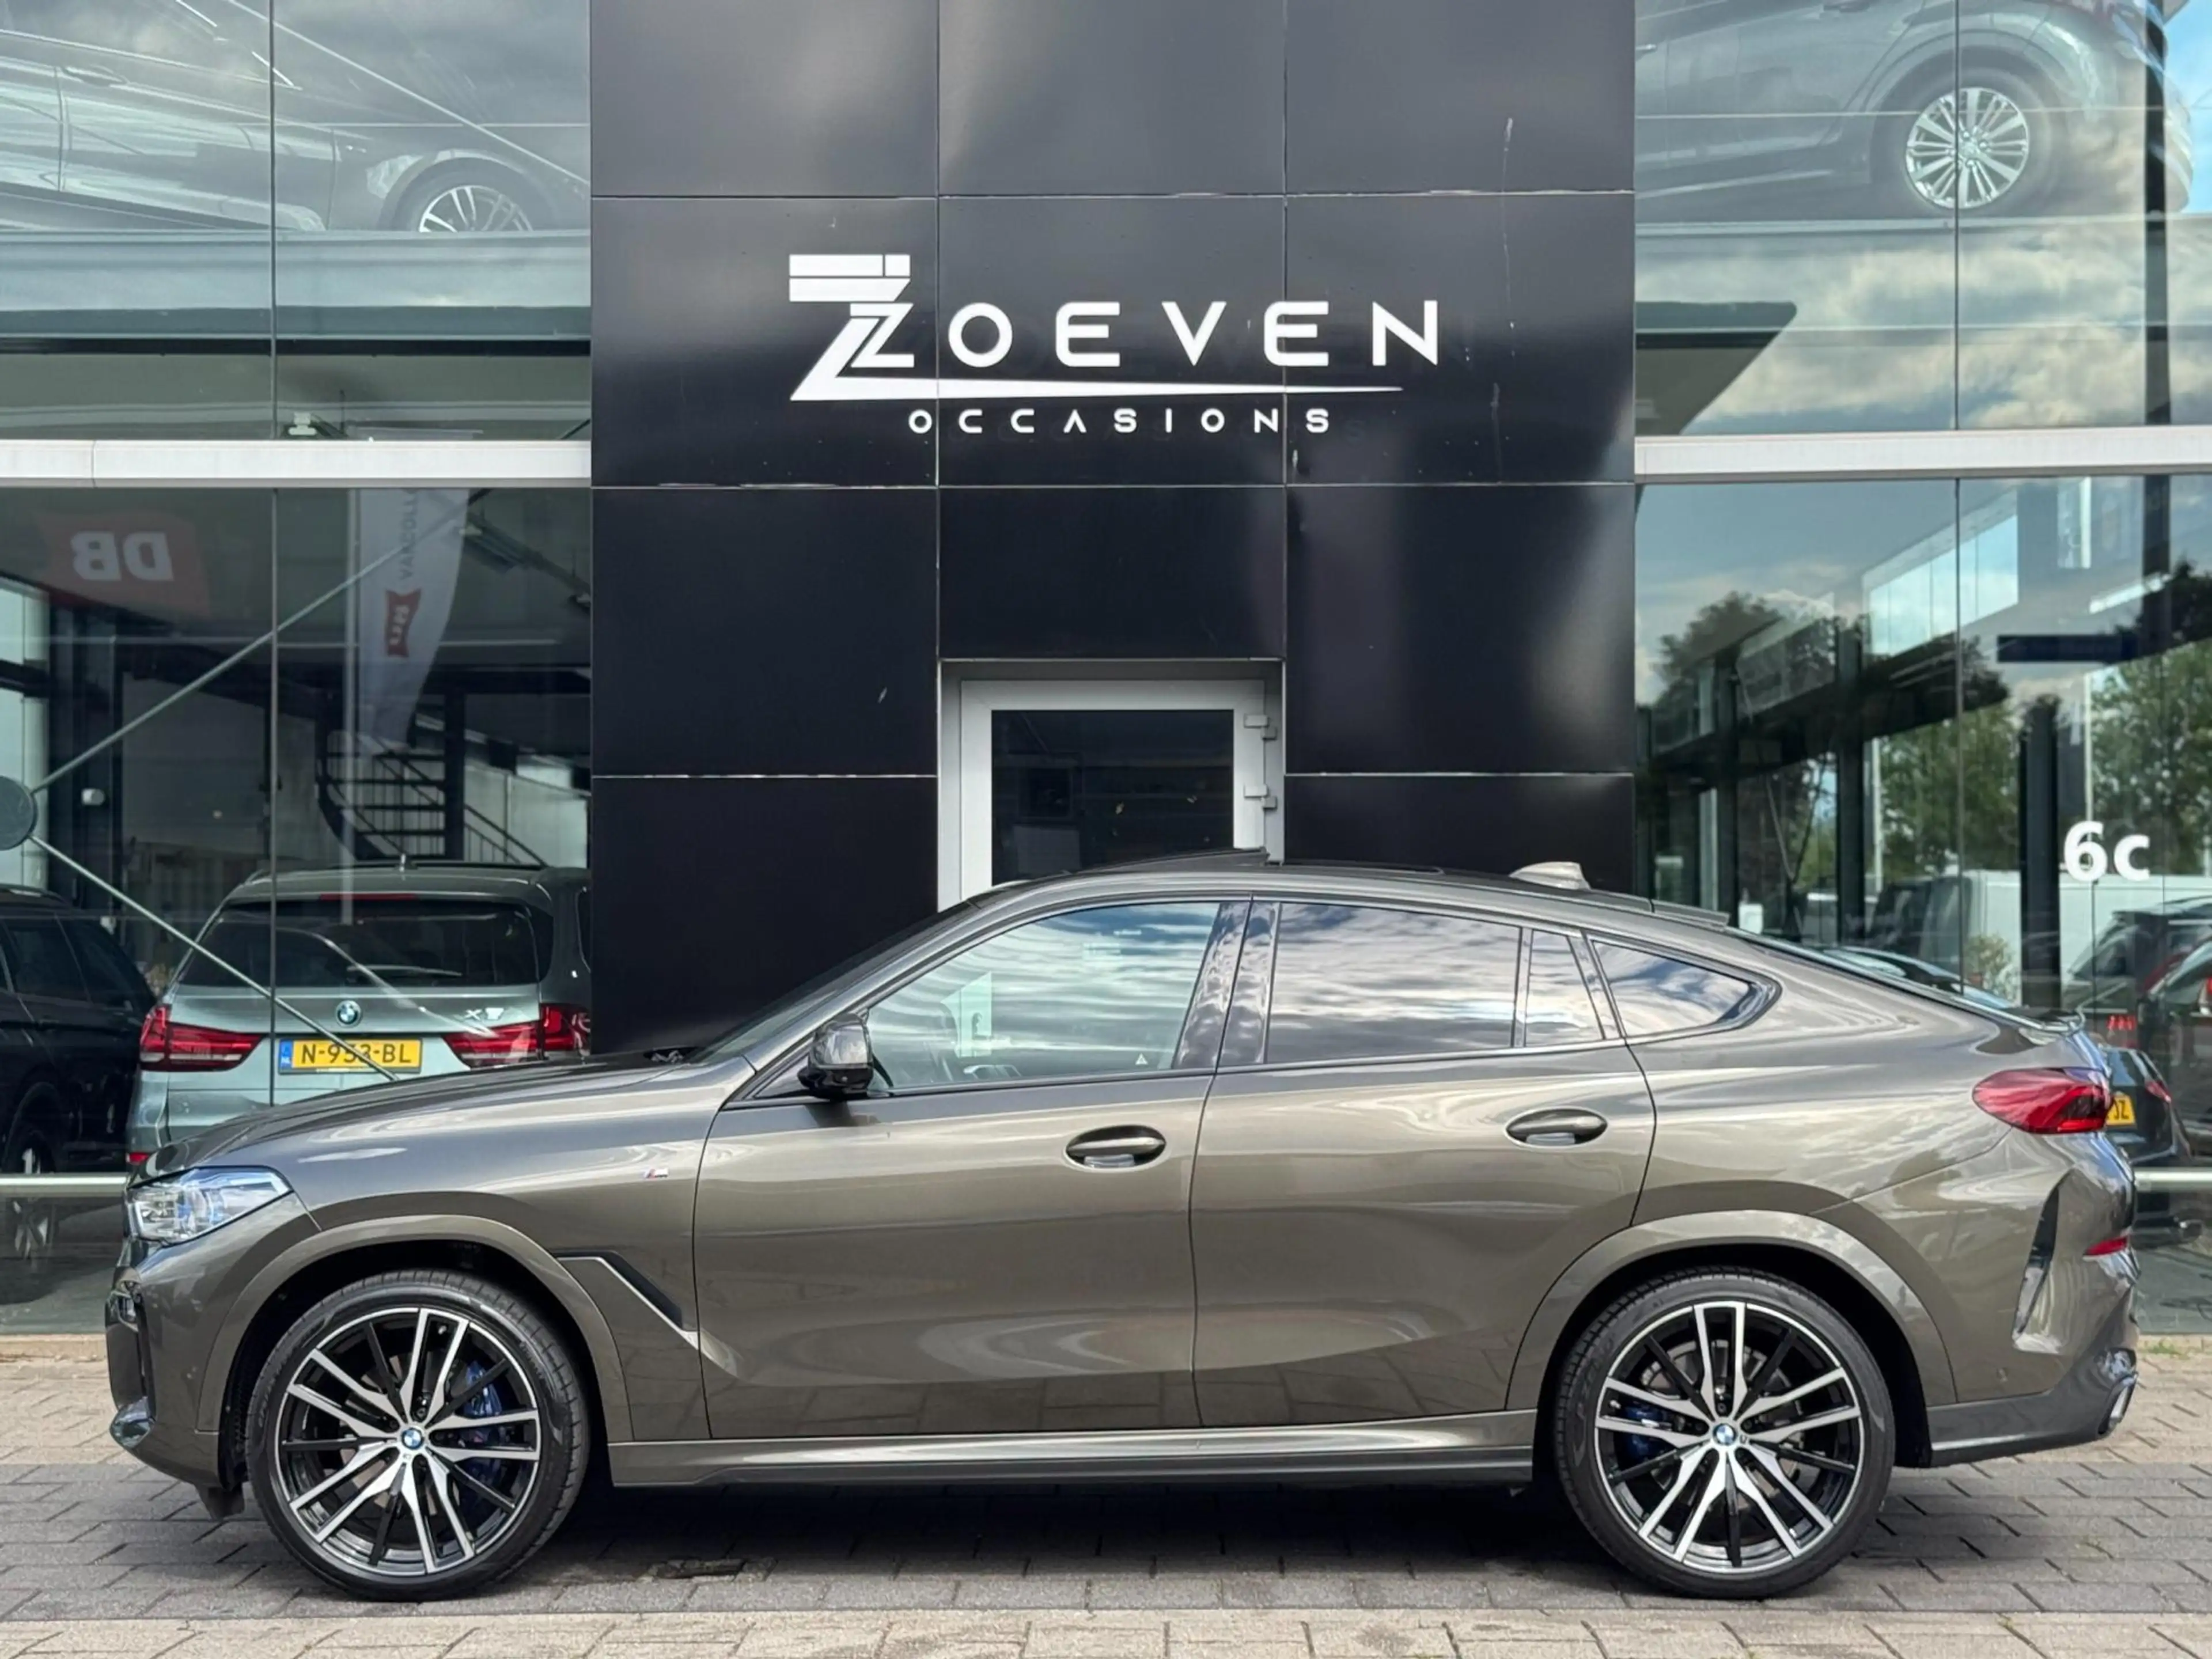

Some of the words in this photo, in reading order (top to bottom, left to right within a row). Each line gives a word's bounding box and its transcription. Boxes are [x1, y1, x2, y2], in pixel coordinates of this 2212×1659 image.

[790, 255, 1438, 400] ZOEVEN
[908, 408, 1330, 434] OCCASIONS
[2064, 820, 2150, 881] 6c
[301, 1043, 412, 1064] N-953-BL
